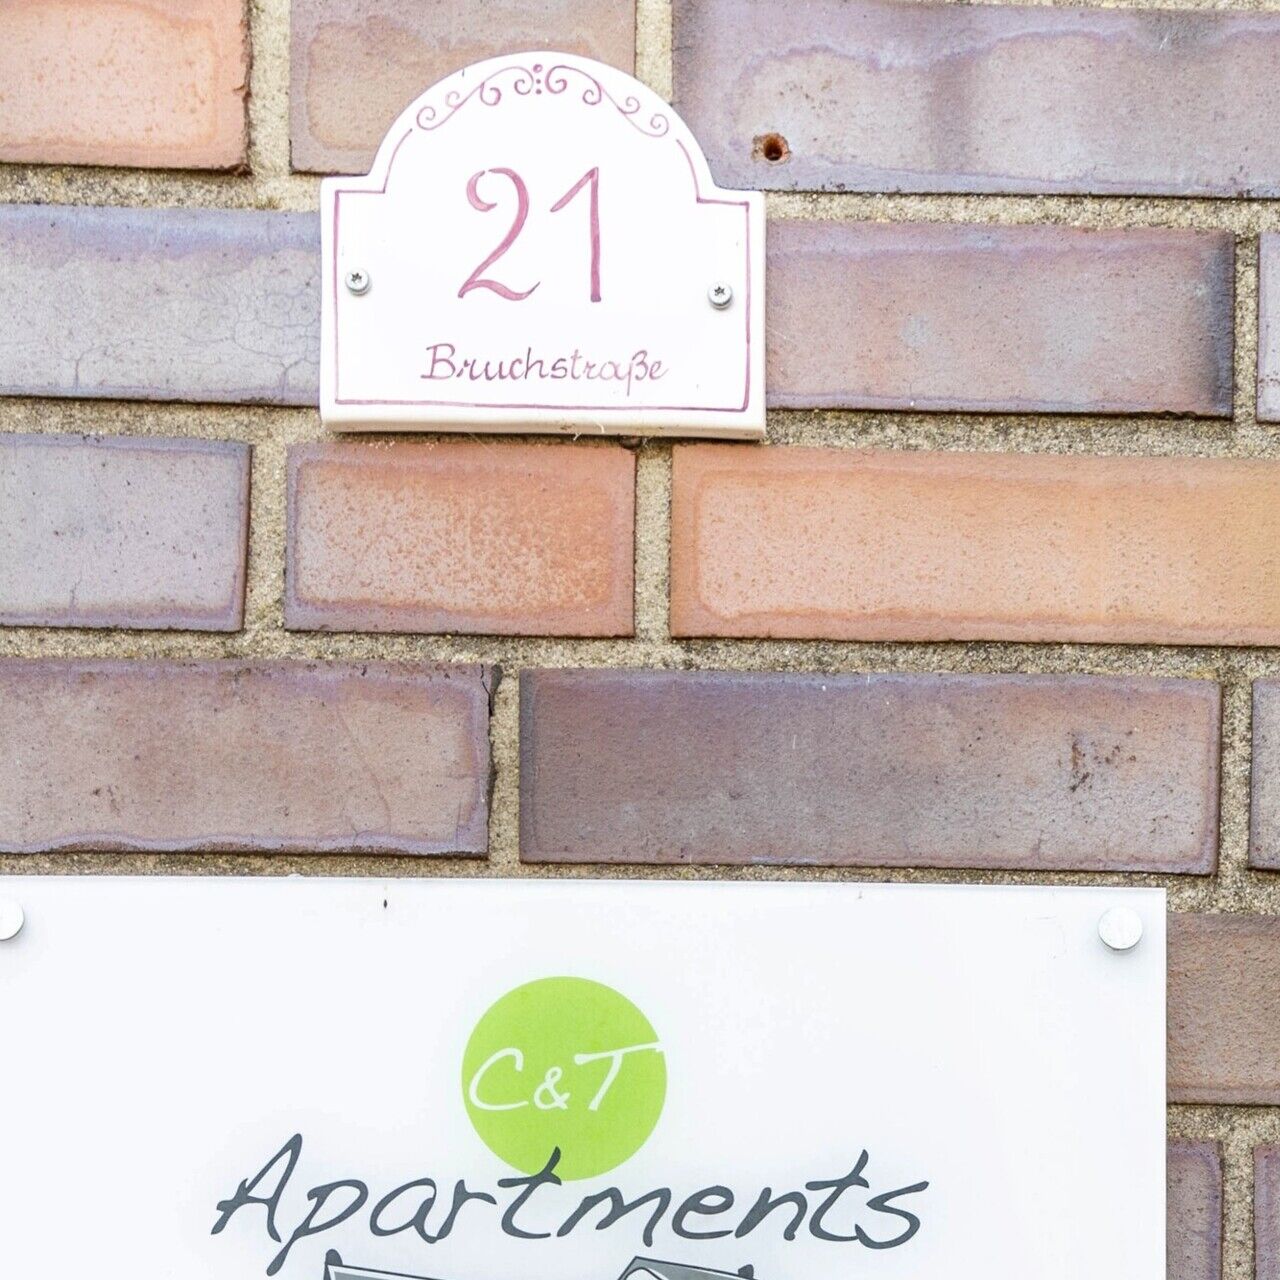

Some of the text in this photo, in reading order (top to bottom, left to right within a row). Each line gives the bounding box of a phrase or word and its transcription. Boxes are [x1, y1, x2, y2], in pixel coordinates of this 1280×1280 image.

[458, 166, 602, 304] 21
[419, 343, 669, 397] Bruchstraße
[468, 1041, 665, 1112] C&T
[210, 1132, 930, 1277] Apartments
